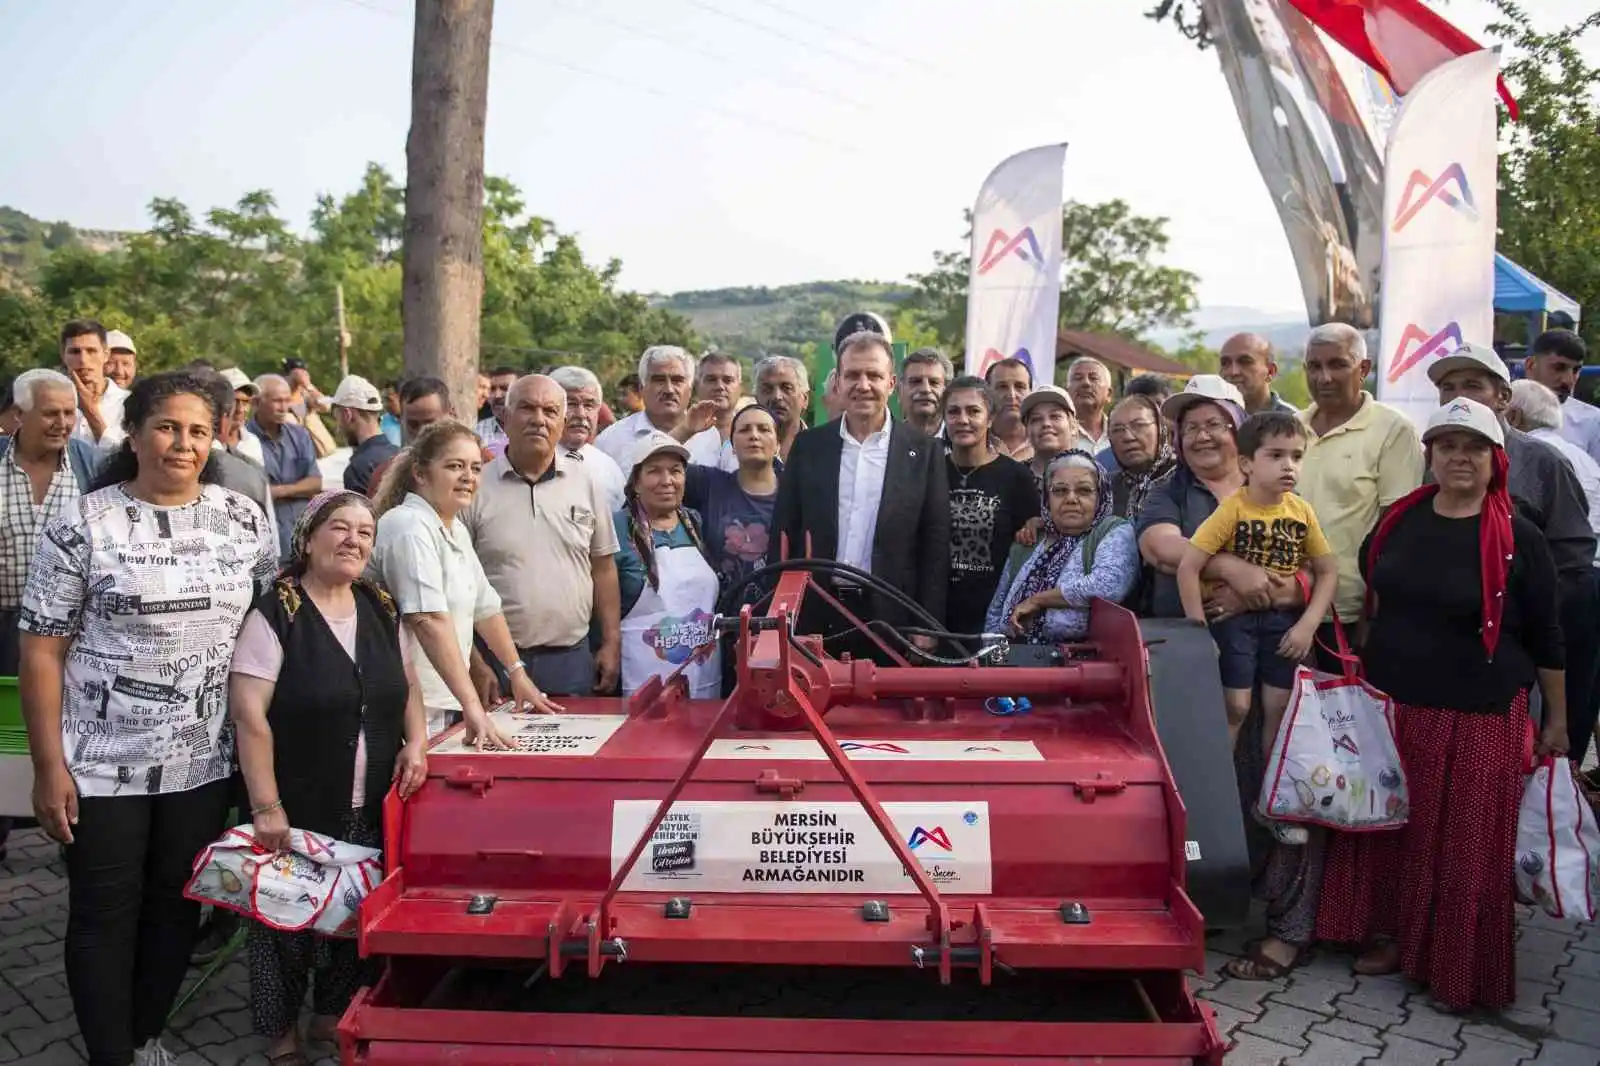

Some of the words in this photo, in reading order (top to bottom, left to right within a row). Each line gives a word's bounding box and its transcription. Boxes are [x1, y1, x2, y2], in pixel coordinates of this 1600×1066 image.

[118, 552, 146, 564] New
[150, 554, 178, 566] York
[168, 599, 208, 610] MONDAY
[131, 704, 152, 715] The
[664, 813, 691, 822] ESTEK
[774, 810, 837, 826] MERSİN
[653, 831, 698, 841] EHİR'DEN
[751, 828, 855, 849] BÜYÜKŞEHİR
[759, 846, 847, 864] BELEDİYESİ
[742, 865, 865, 882] ARMAĞANIDIR
